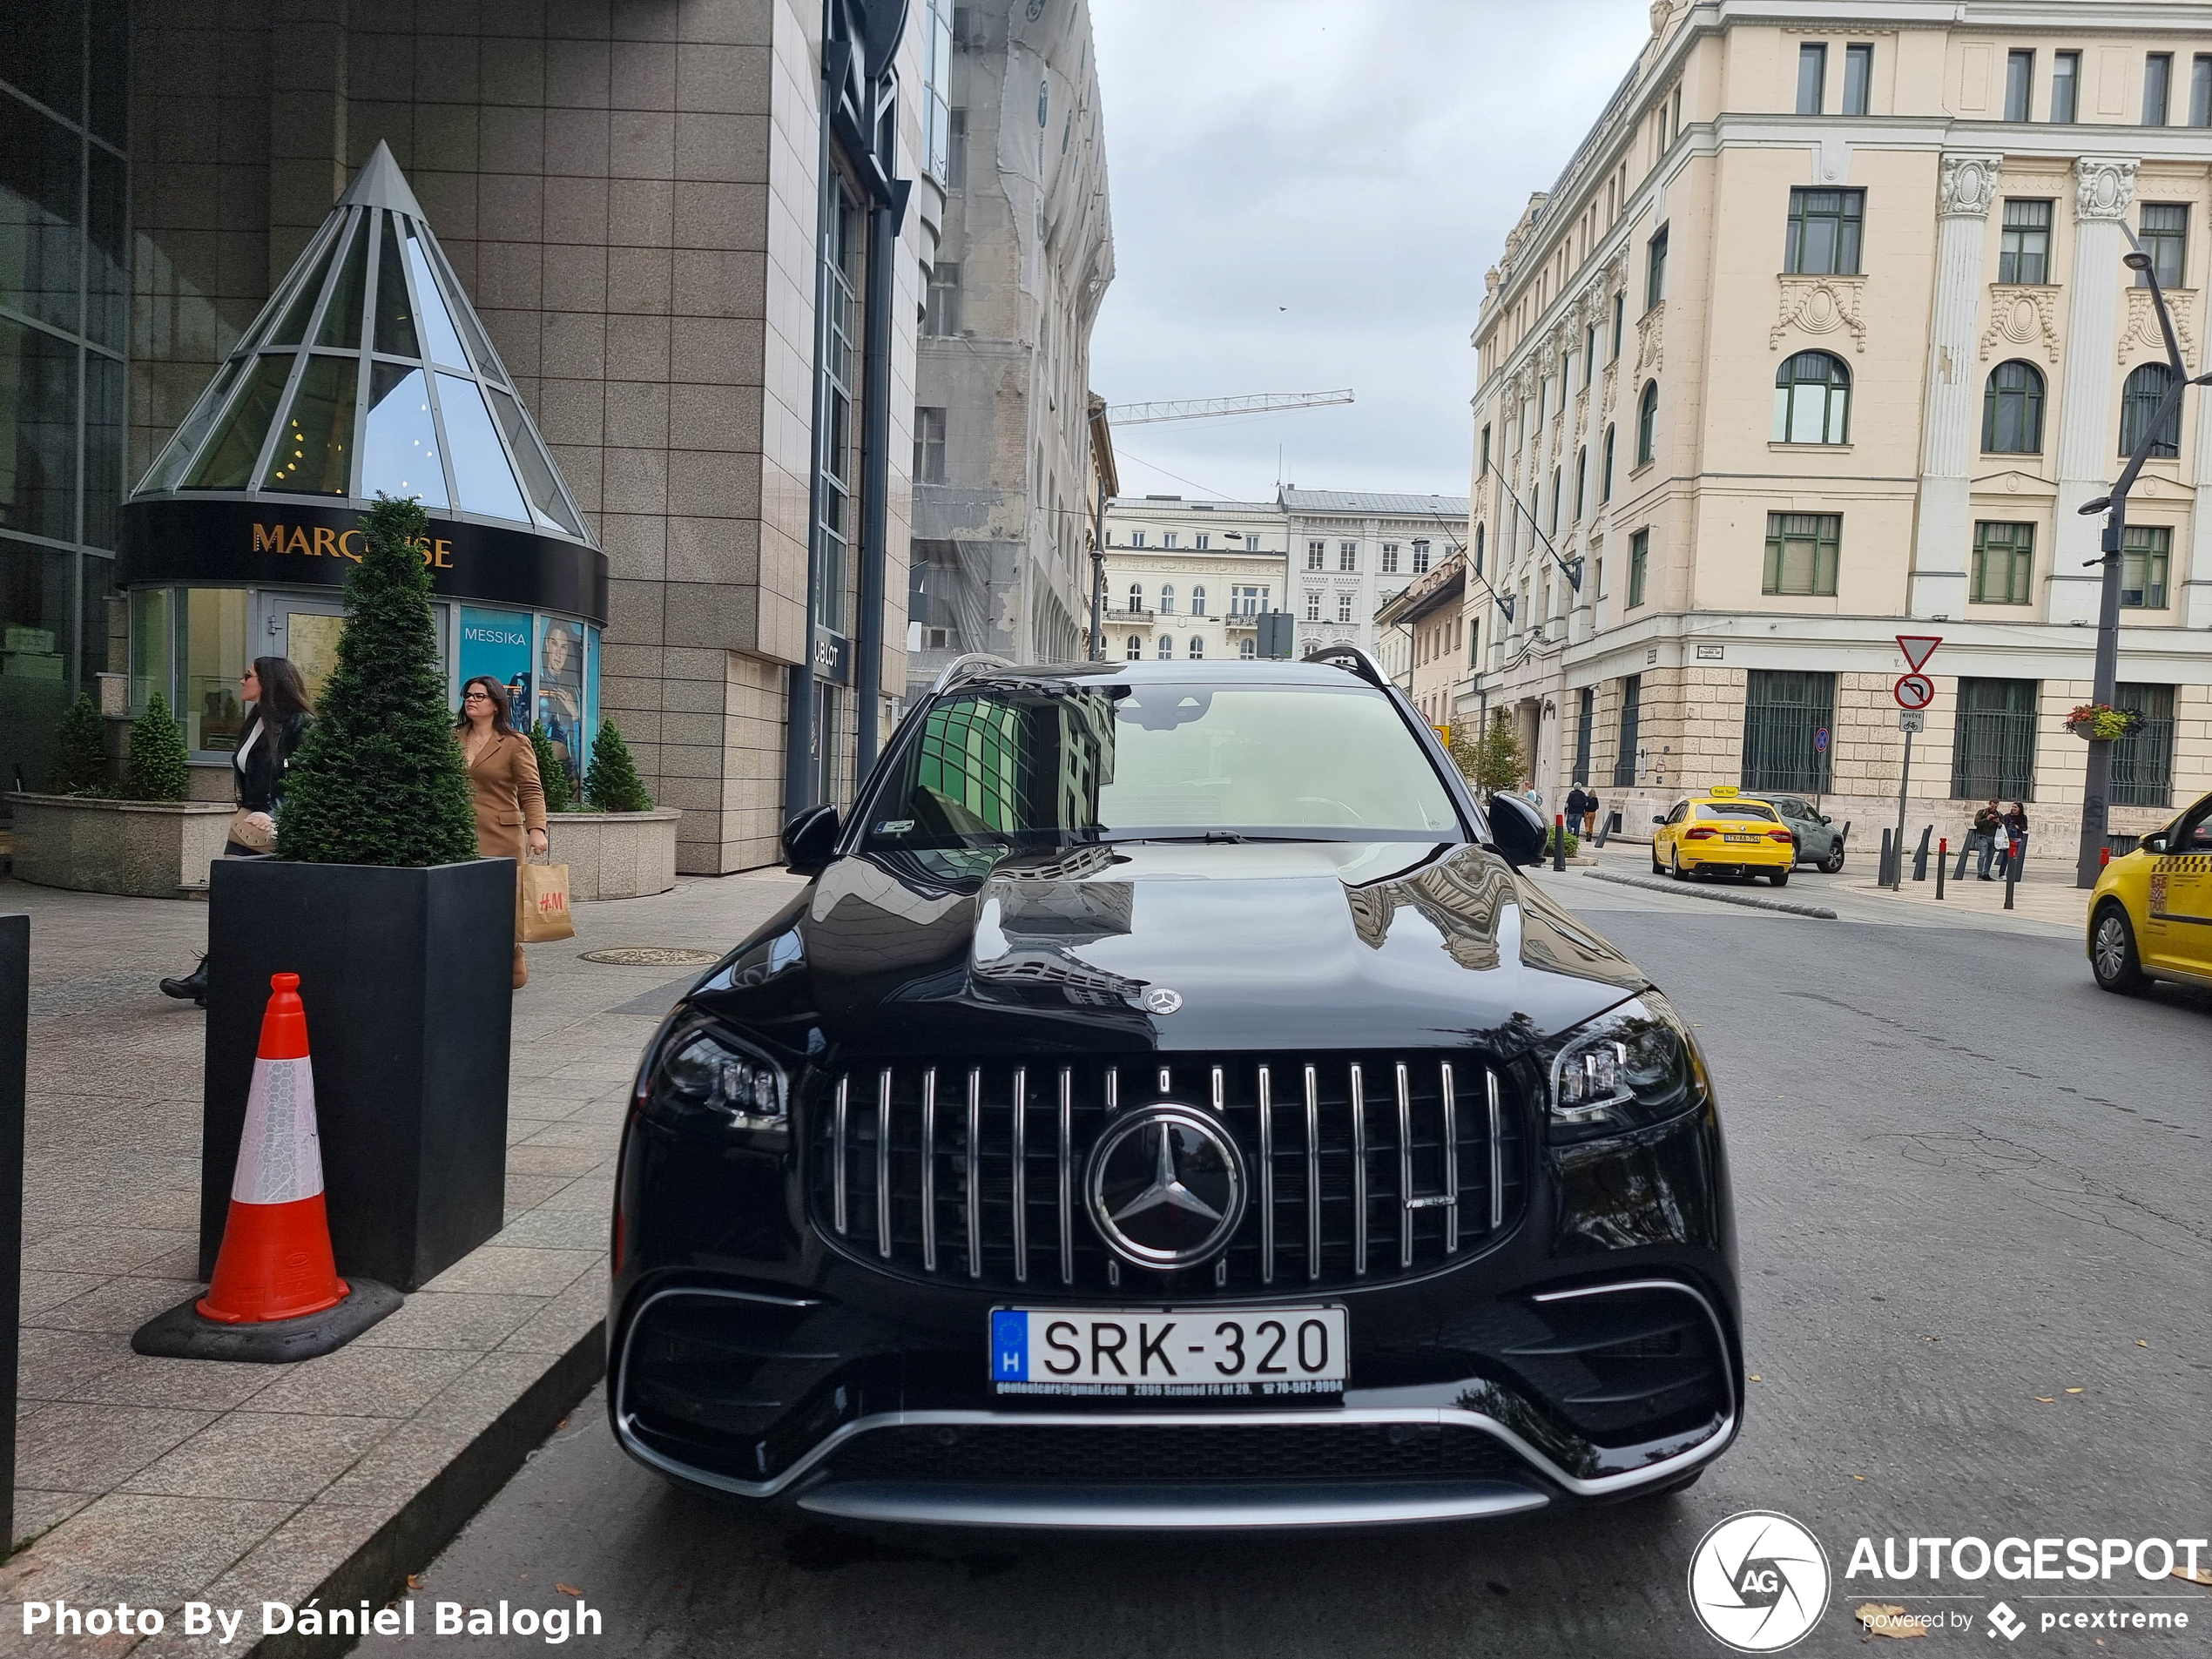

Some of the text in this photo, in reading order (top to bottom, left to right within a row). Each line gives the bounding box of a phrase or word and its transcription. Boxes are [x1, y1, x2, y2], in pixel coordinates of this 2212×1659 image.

[253, 523, 454, 569] MARQSE
[465, 627, 527, 646] MESSIKA
[814, 639, 838, 667] UBLOT
[539, 892, 563, 912] H&M
[1044, 1319, 1329, 1376] SRK-320
[1003, 1352, 1019, 1372] H
